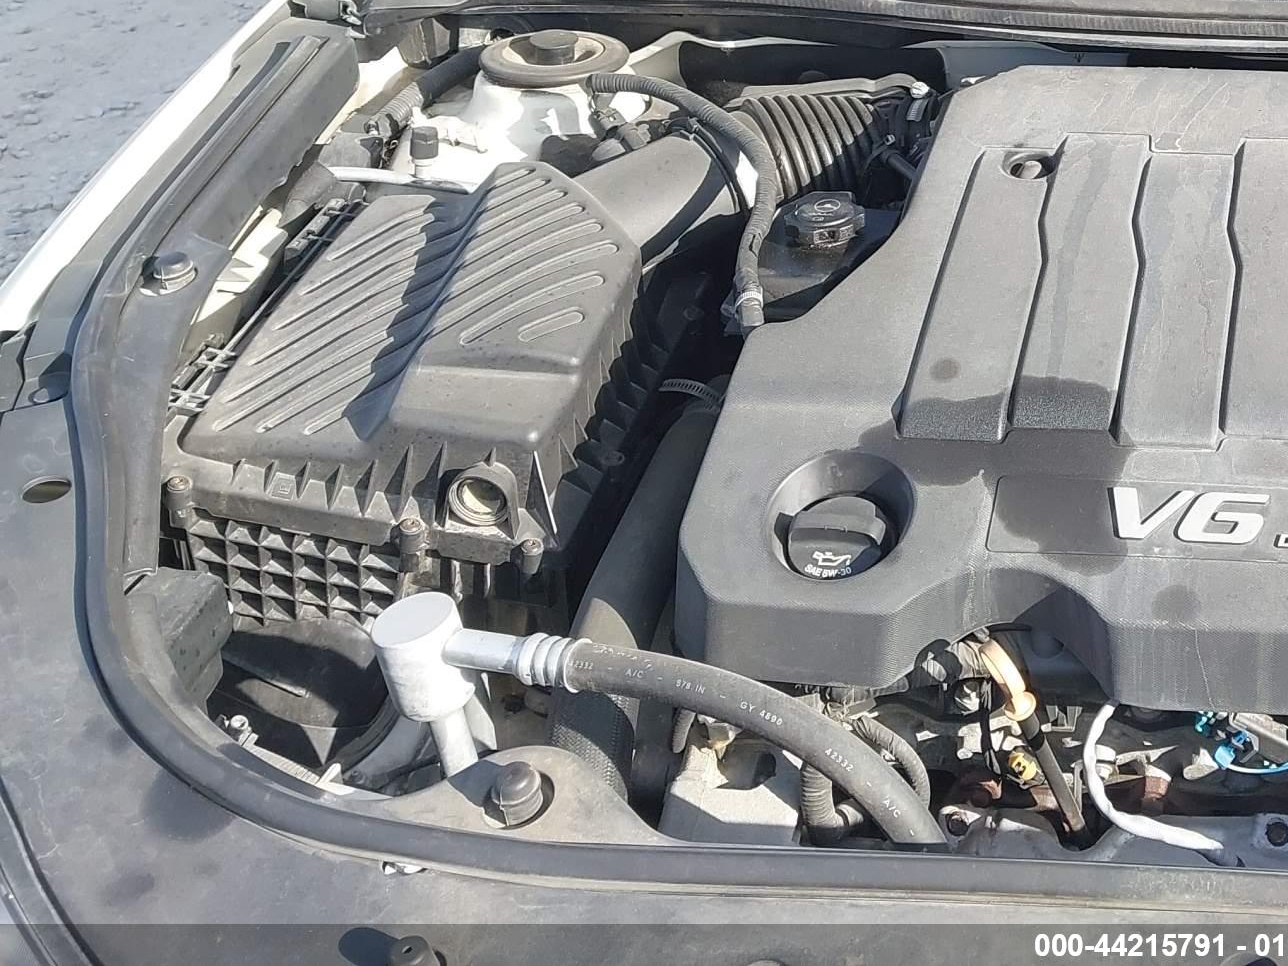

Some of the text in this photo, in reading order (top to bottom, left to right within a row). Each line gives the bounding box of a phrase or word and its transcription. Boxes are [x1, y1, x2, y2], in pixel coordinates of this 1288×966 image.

[1108, 487, 1271, 545] V6
[804, 563, 852, 578] SAE 5W-30
[625, 668, 644, 679] A/C
[740, 701, 755, 712] GY
[759, 709, 783, 726] 4890
[883, 795, 901, 818] A/C
